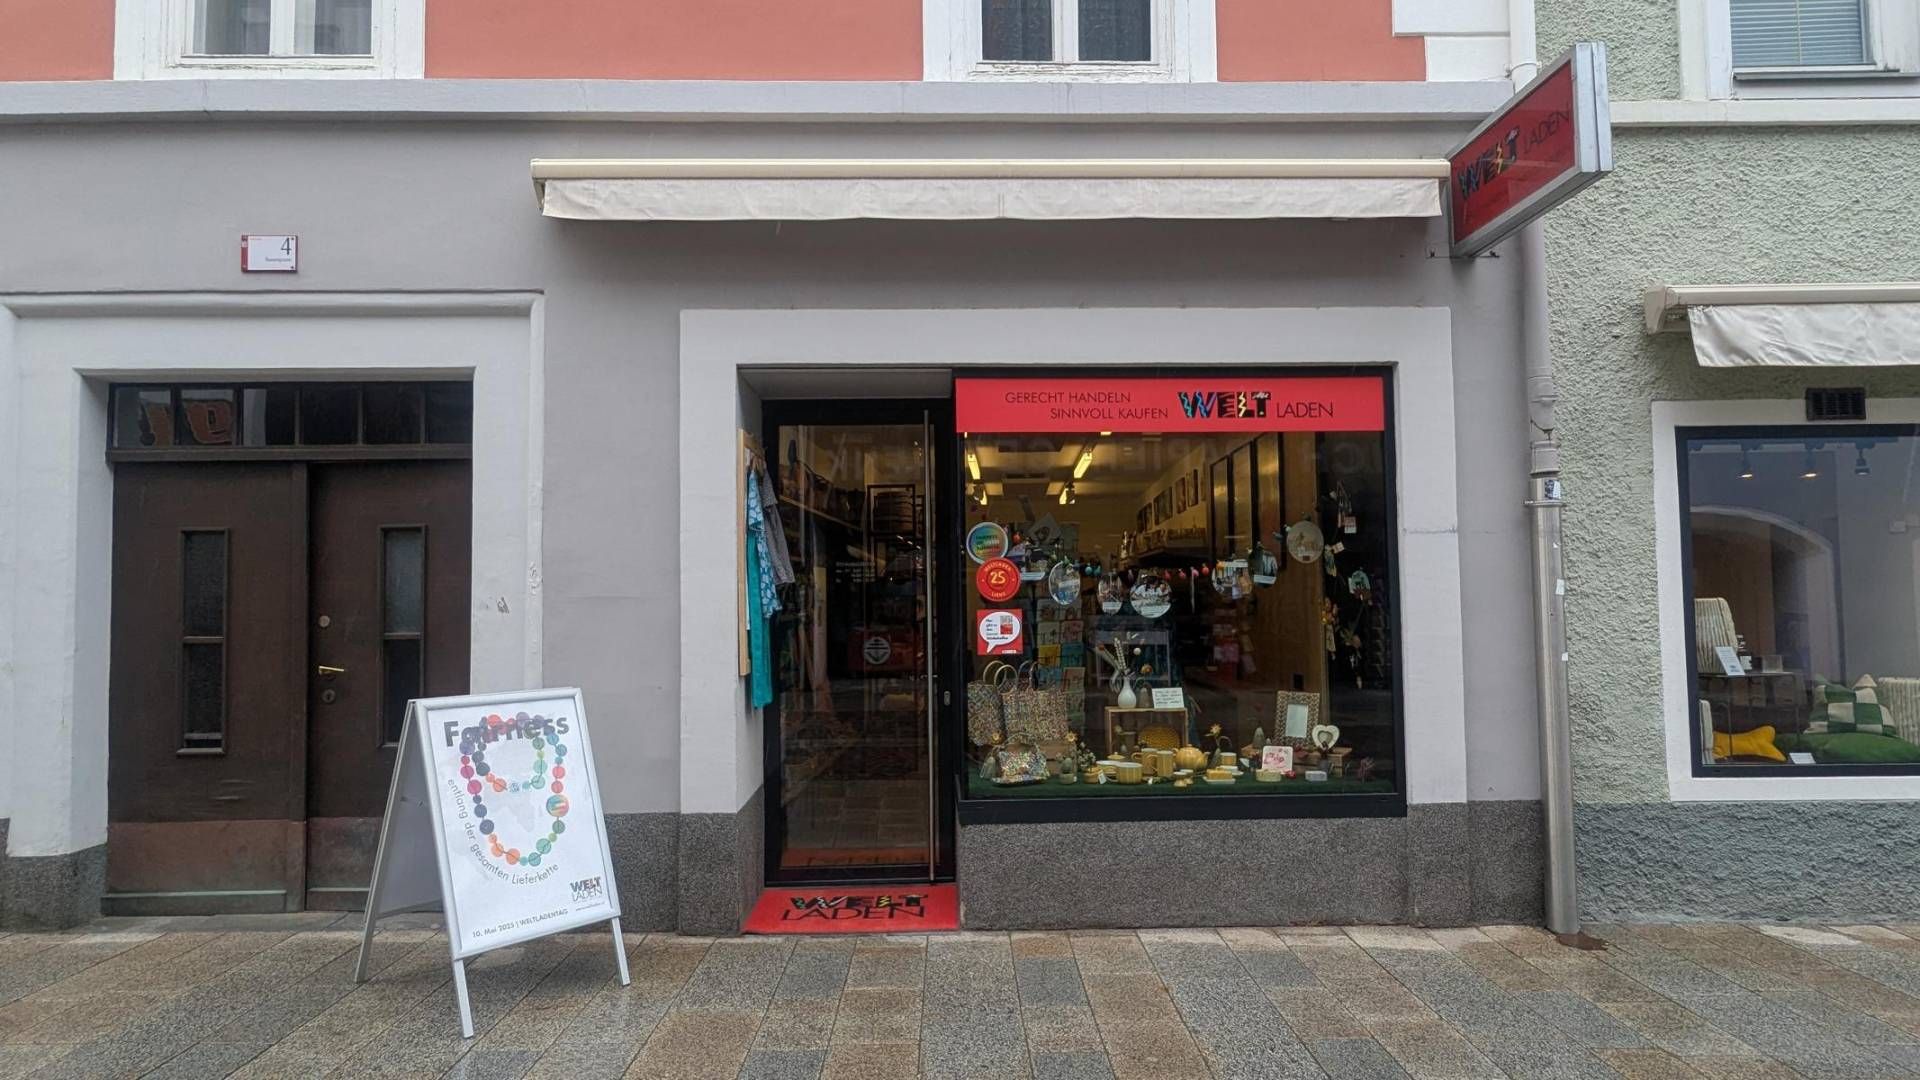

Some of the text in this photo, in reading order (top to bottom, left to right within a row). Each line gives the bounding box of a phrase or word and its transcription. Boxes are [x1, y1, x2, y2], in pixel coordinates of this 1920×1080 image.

[1457, 103, 1570, 199] WELT LADEN
[281, 237, 292, 255] 4
[1005, 392, 1130, 403] GERECHT HANDELN
[1177, 391, 1333, 418] WELT LADEN
[1050, 408, 1168, 419] SINNVOLL KAUFEN
[990, 571, 1006, 584] 25
[444, 716, 570, 748] Fairness
[448, 778, 559, 885] entlang der gesamten Lieferkette
[570, 876, 601, 893] WELT
[571, 887, 602, 902] LADEN
[790, 894, 928, 910] WELT
[782, 906, 925, 920] LADEN
[472, 929, 483, 938] 10.
[484, 926, 497, 935] Mai
[520, 908, 568, 926] WELTLADENTAG
